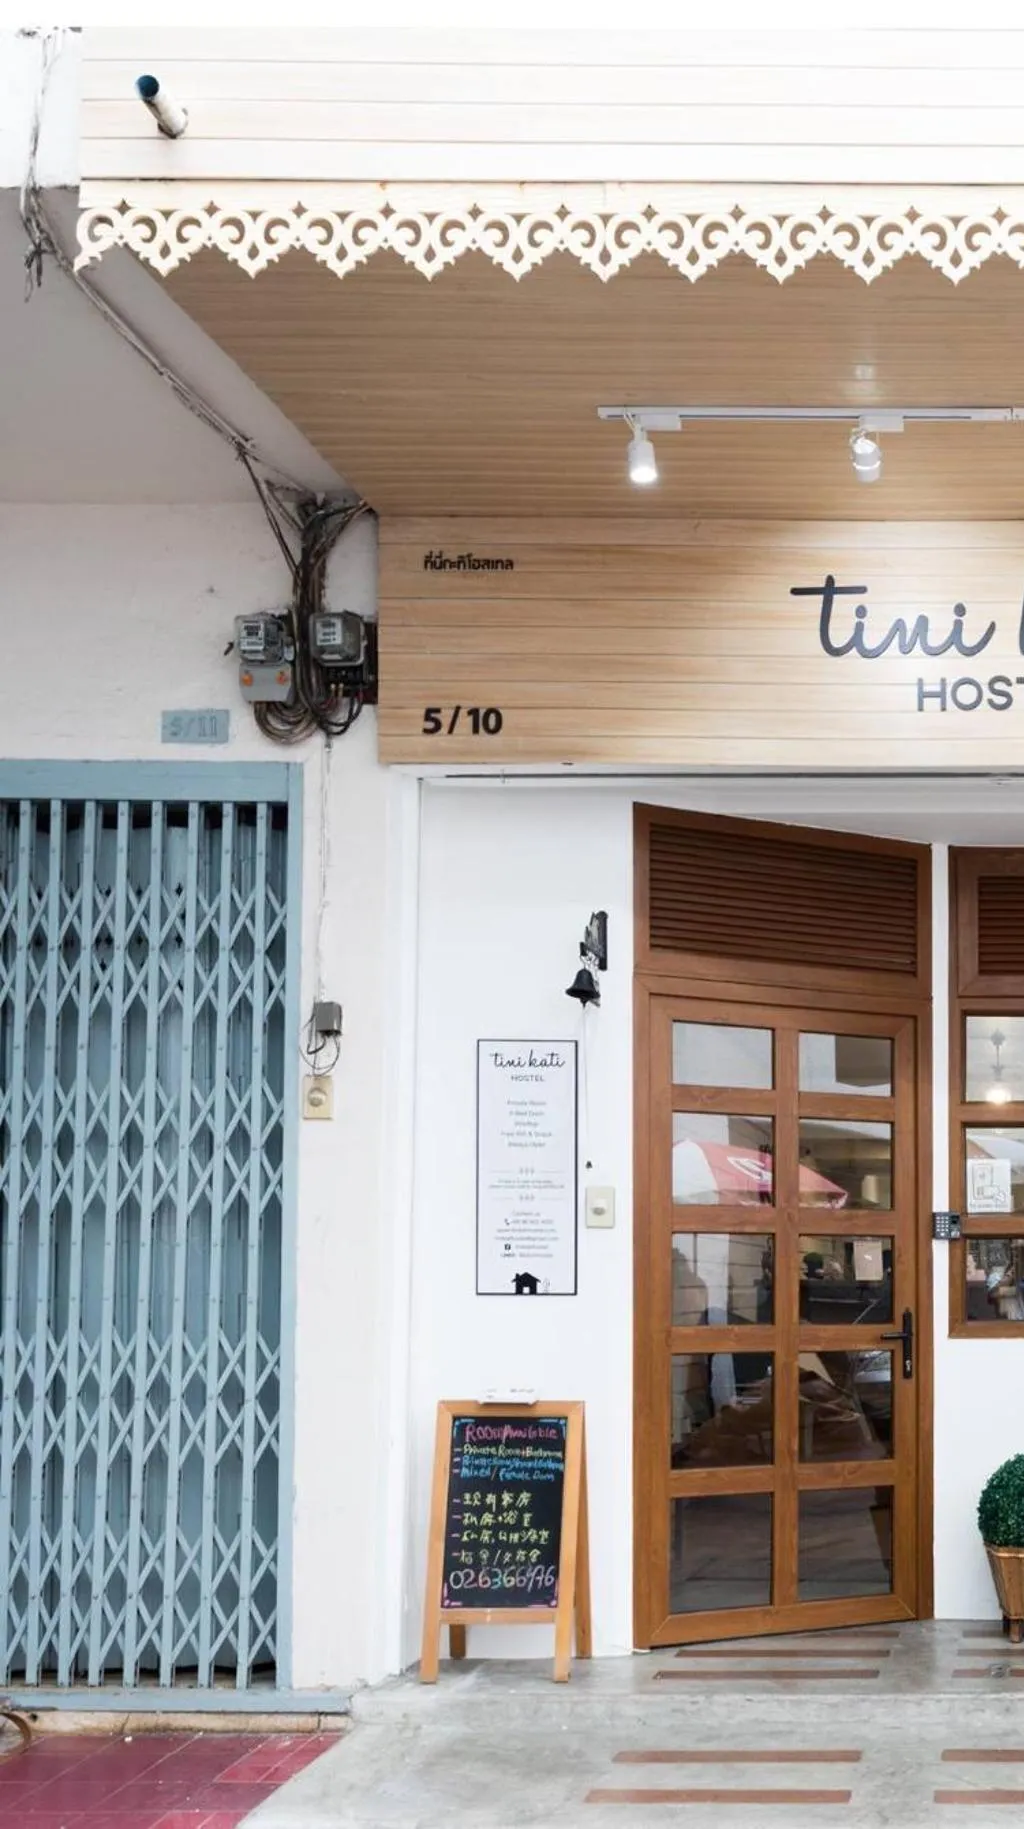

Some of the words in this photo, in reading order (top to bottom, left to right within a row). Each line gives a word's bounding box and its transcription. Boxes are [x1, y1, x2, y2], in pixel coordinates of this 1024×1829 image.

[789, 574, 997, 659] tini
[422, 705, 503, 736] 5/10
[510, 1074, 546, 1082] HOSTEL
